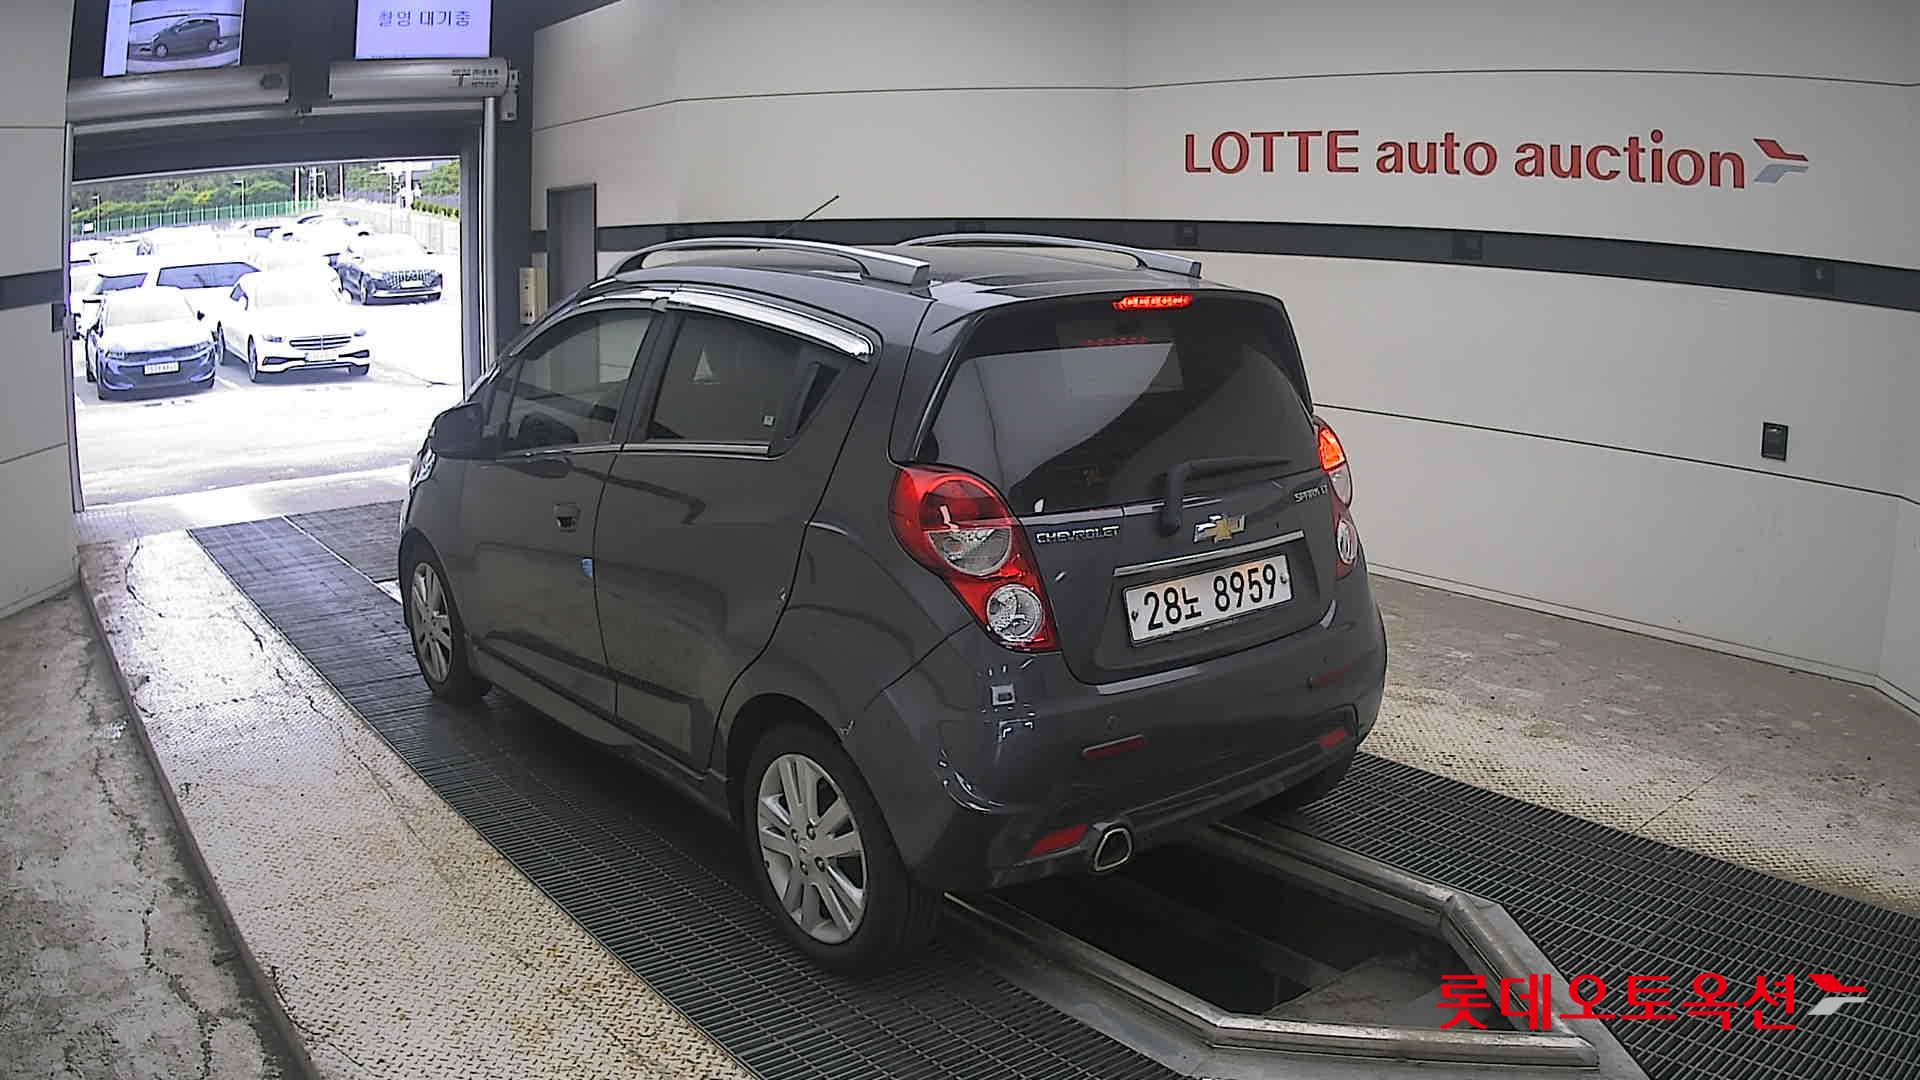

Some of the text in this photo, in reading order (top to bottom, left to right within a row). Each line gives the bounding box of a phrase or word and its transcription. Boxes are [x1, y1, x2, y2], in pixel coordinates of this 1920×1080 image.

[419, 10, 471, 27] 대기중
[1185, 130, 1746, 189] LOTTE auto auction
[1036, 525, 1120, 543] CHEVROLET
[1143, 563, 1277, 631] 28노 8959
